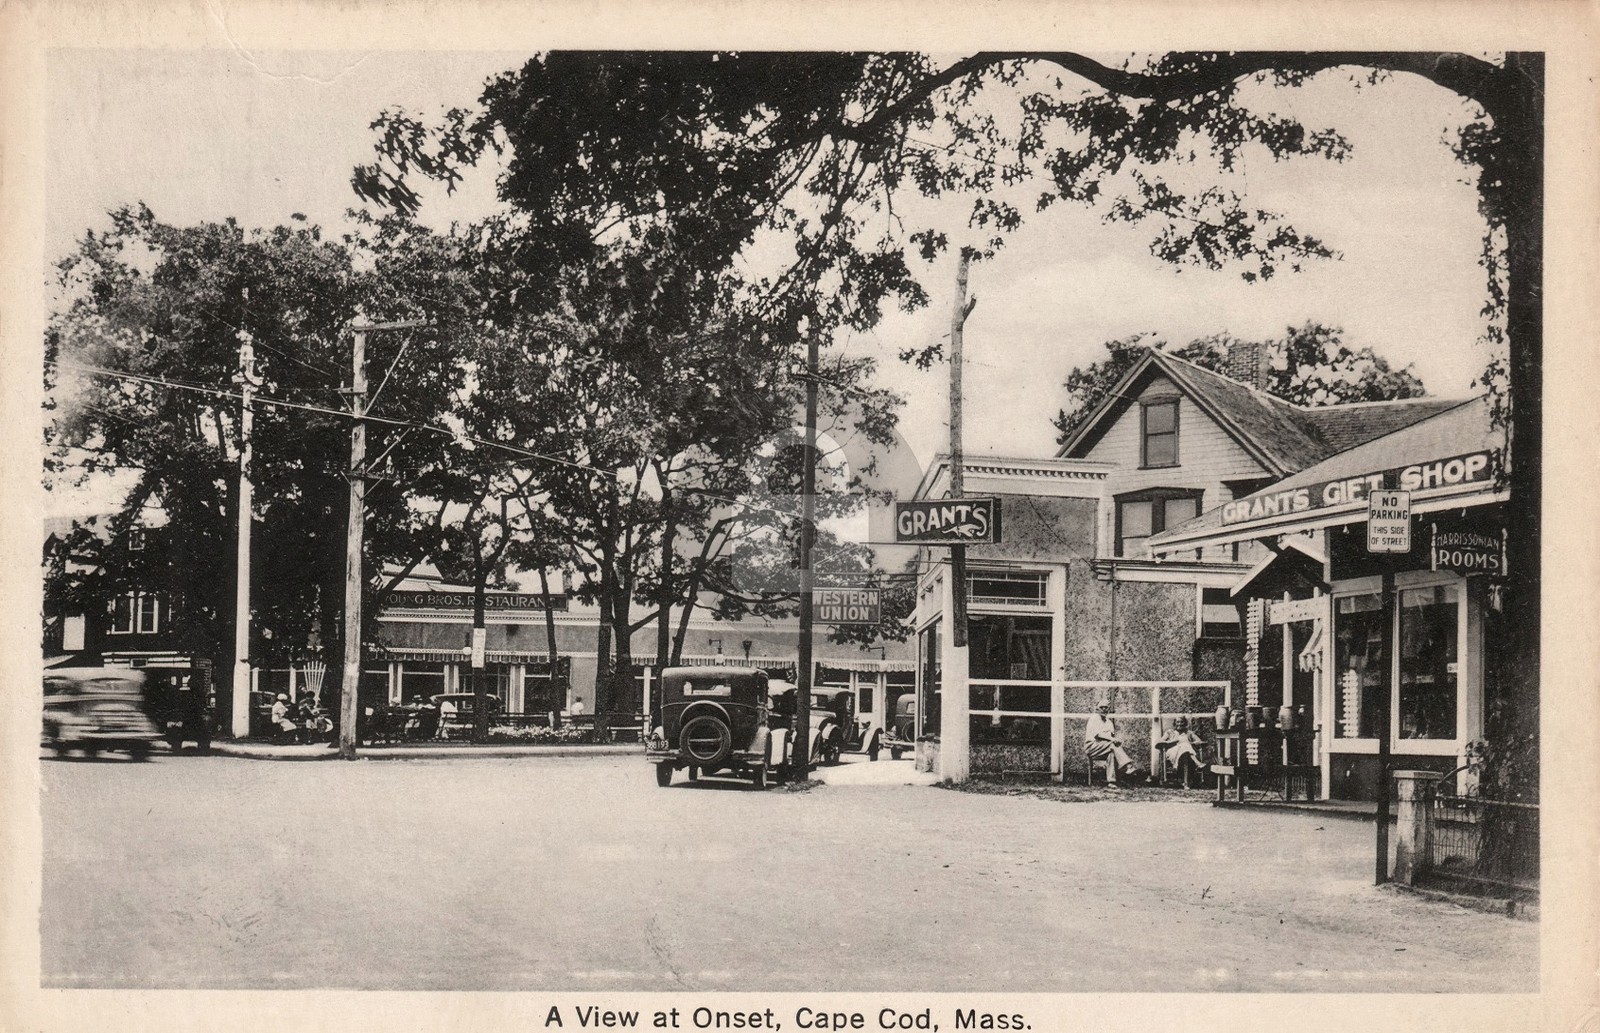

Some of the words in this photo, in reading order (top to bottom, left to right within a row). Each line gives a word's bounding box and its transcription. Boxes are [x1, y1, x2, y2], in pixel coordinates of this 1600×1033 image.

[1322, 474, 1384, 506] GIFT
[1401, 454, 1488, 490] SHOP
[1382, 497, 1398, 507] NO
[898, 503, 987, 537] GRANT'S
[1371, 509, 1408, 520] PARKING
[1373, 526, 1388, 535] THIS
[1390, 526, 1405, 535] SIDE
[1371, 536, 1379, 545] OF
[1382, 537, 1407, 546] STREET
[1437, 549, 1499, 568] ROOMS
[427, 594, 464, 606] BROS.
[467, 595, 555, 608] RSTAURAN
[820, 606, 869, 621] UNION
